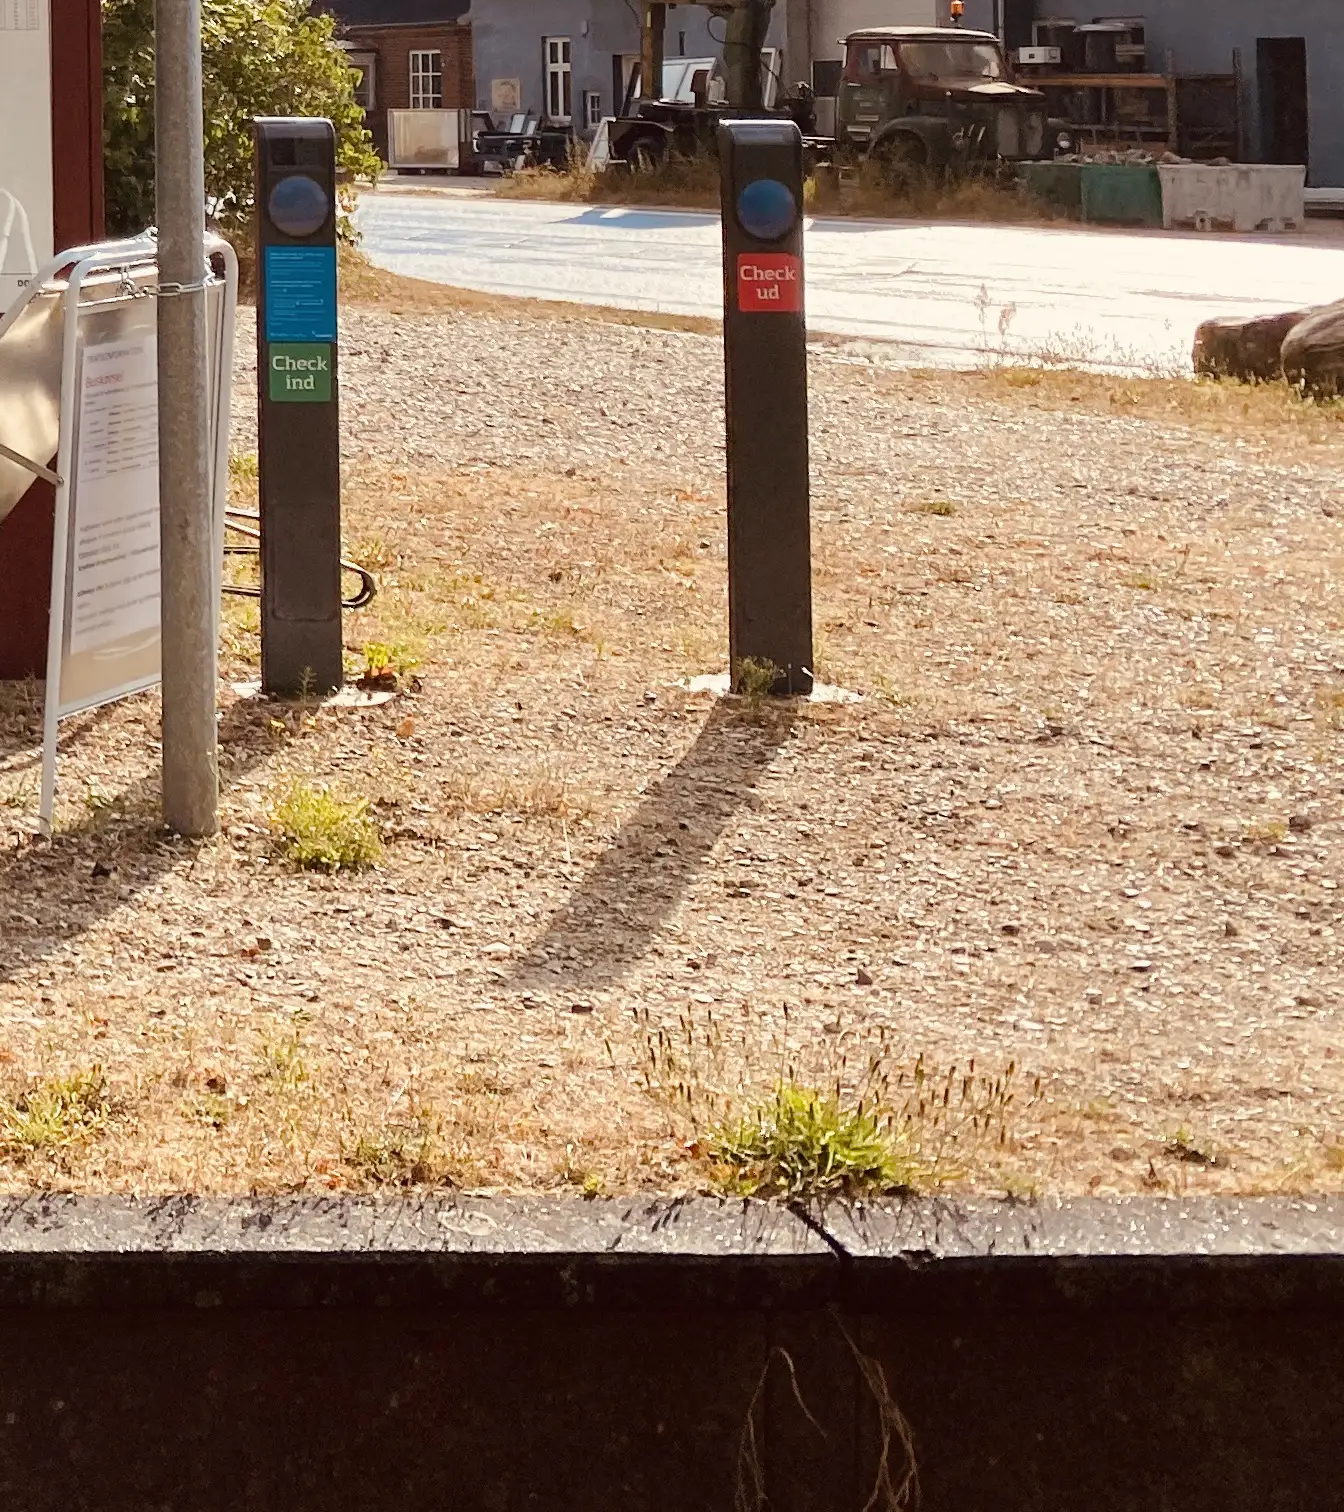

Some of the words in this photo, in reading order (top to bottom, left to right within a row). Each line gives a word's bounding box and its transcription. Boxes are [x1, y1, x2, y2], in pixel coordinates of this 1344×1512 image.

[740, 265, 796, 281] Check
[756, 284, 780, 300] ud
[272, 355, 328, 371] Check
[285, 374, 315, 390] ind
